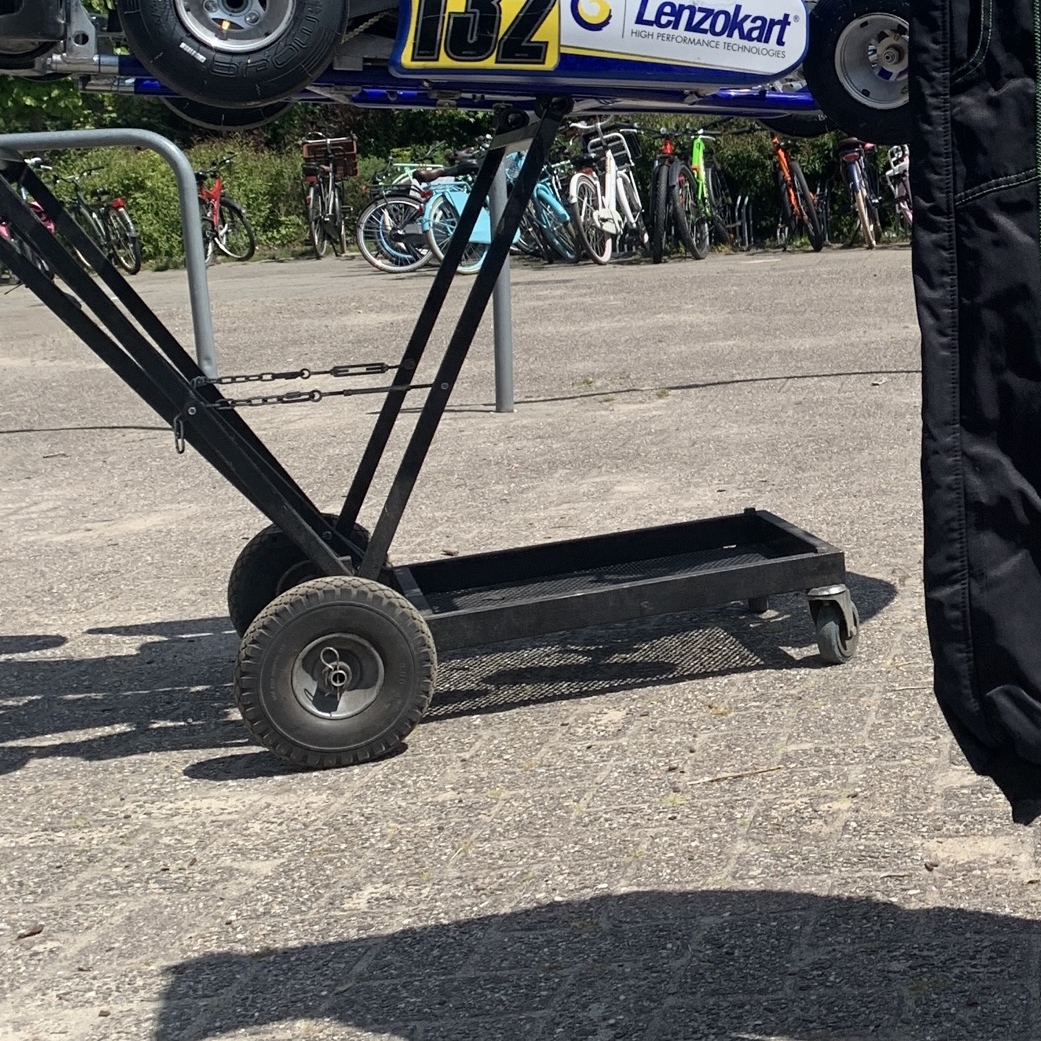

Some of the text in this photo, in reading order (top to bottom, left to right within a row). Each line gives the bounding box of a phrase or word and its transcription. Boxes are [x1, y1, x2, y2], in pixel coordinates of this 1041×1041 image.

[631, 29, 786, 59] HIGH PERFORMANCE TECHNOLOGIES
